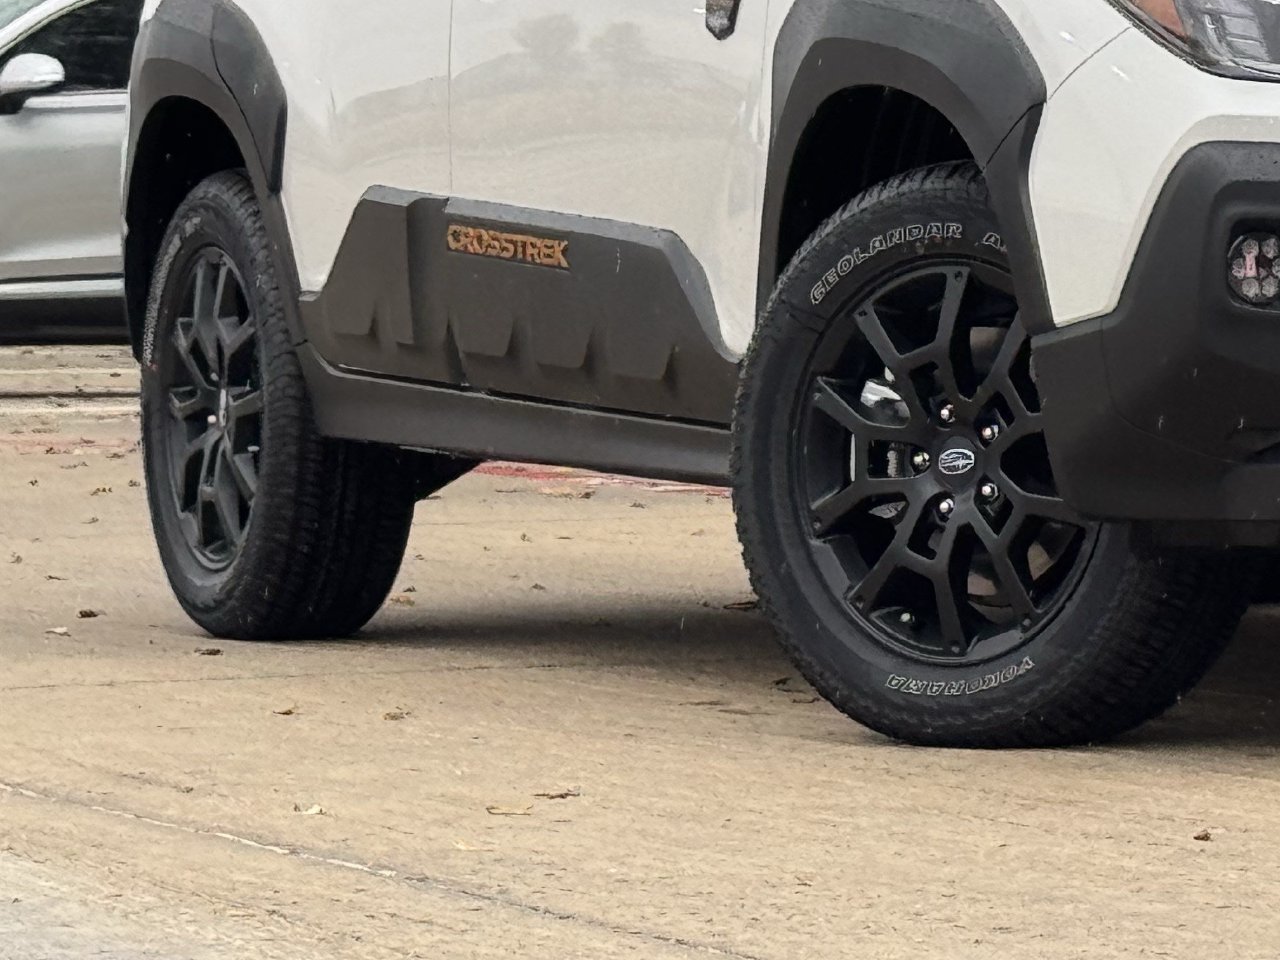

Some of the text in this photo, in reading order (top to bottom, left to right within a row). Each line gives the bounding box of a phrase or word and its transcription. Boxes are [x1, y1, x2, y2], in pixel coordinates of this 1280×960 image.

[447, 224, 569, 268] CROSSTREK
[810, 222, 963, 304] GEOLANDAR
[885, 655, 1035, 696] YOKOHAMA
